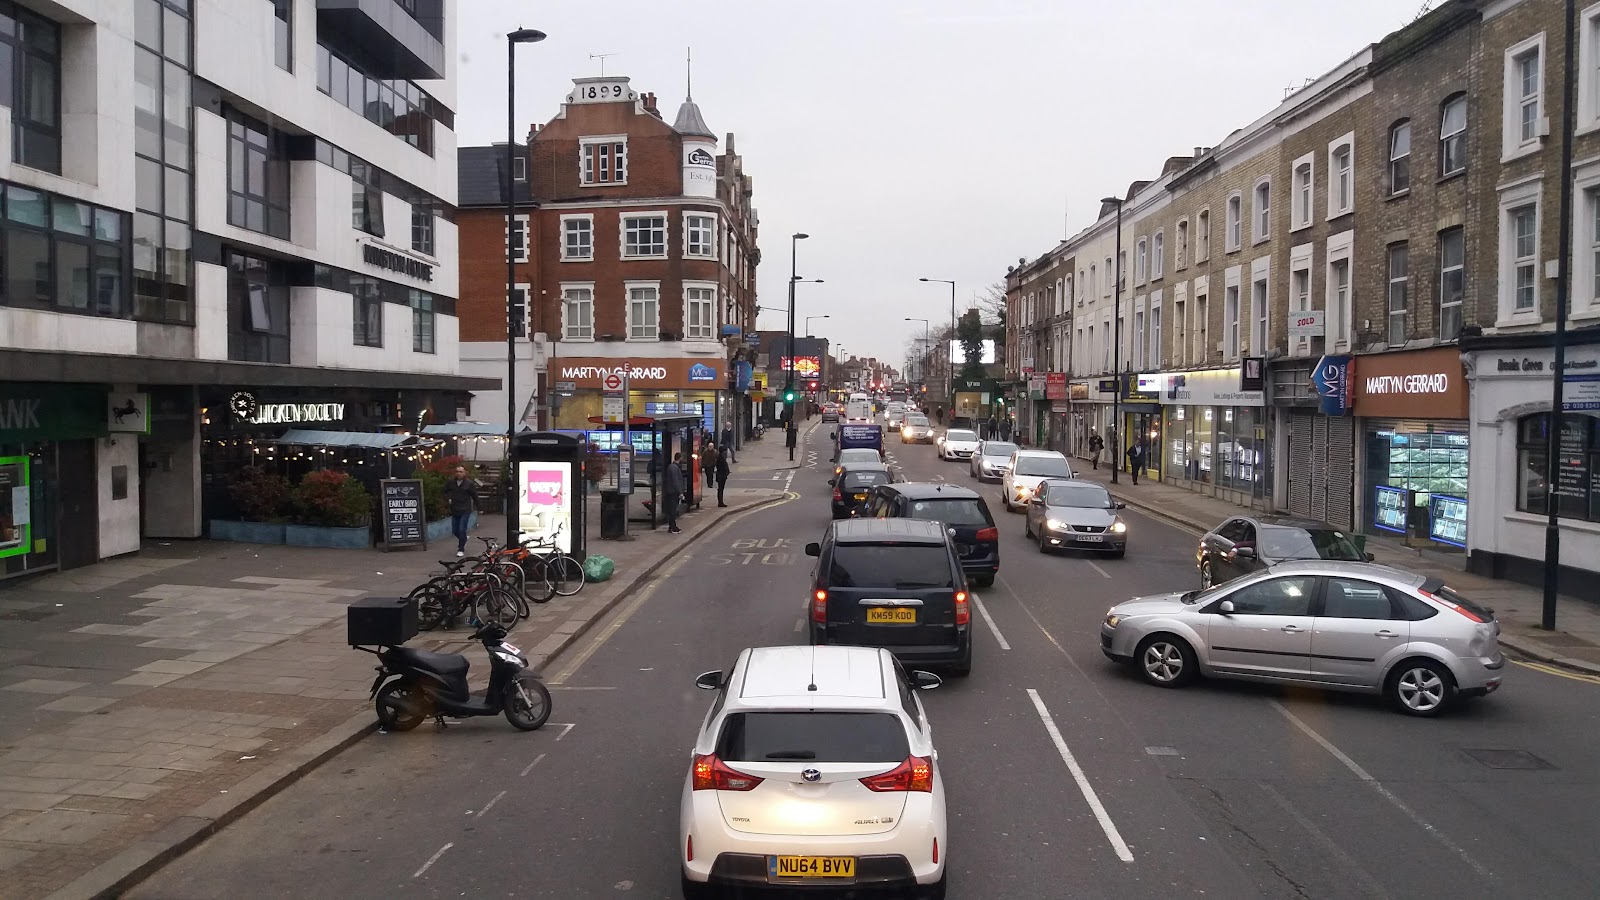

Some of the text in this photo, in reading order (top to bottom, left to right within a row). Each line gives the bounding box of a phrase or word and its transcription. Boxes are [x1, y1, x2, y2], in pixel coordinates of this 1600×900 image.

[582, 85, 622, 99] 1899
[363, 244, 432, 282] WINSTON HOUSE
[1296, 317, 1314, 326] SOLD
[624, 363, 629, 371] E
[1522, 358, 1543, 371] Green
[562, 366, 666, 379] MARTYN GRRARD
[692, 368, 708, 376] MG
[1322, 364, 1339, 397] MG
[1366, 373, 1448, 394] MARTYN GERRARD
[0, 399, 40, 429] NK
[302, 404, 344, 422] SOCIETY
[530, 482, 560, 496] very
[405, 499, 417, 507] BIRD
[779, 858, 851, 873] NU64 BVV
